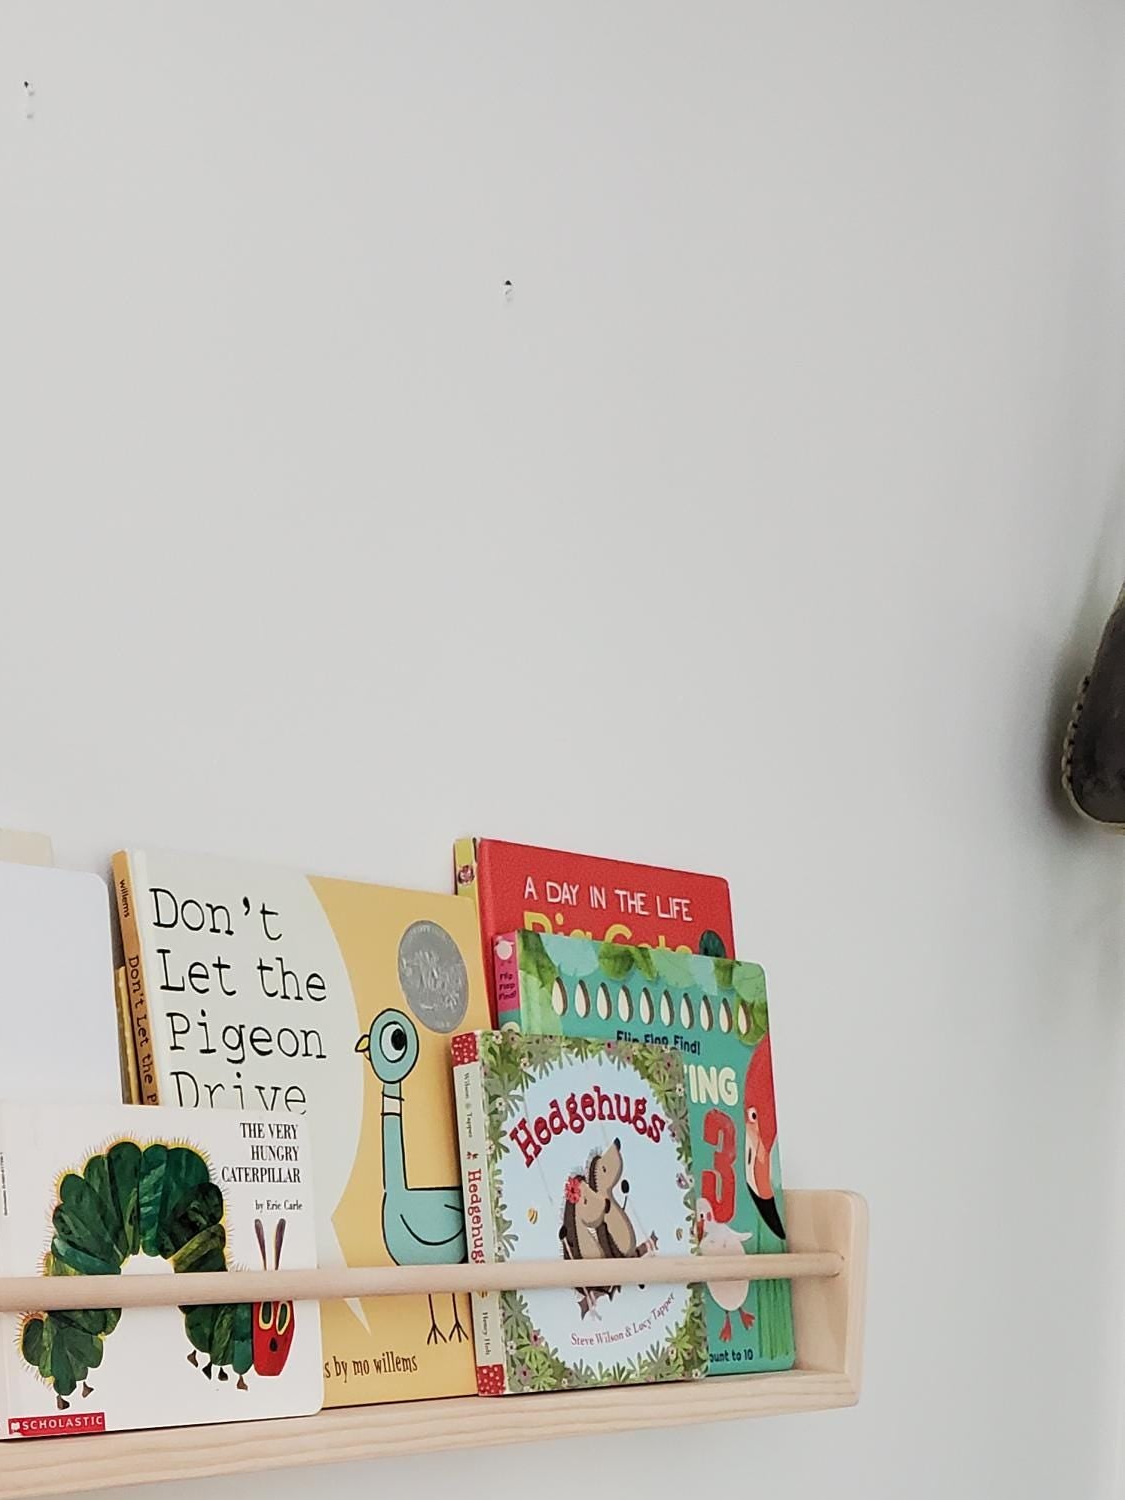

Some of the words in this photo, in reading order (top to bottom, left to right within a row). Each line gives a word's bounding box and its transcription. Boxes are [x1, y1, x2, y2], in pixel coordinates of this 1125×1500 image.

[119, 879, 129, 918] willems
[149, 887, 282, 941] Don't
[524, 876, 539, 900] A
[546, 881, 579, 905] DAY
[590, 884, 607, 910] IN
[614, 889, 649, 915] THE
[656, 895, 693, 922] LIFE
[128, 955, 144, 1007] Don't
[156, 948, 237, 996] Let
[257, 956, 327, 1002] the
[136, 1014, 150, 1048] Let
[166, 1008, 327, 1065] Pigeon
[141, 1052, 153, 1085] the
[170, 1070, 307, 1115] Drive
[240, 1122, 265, 1139] THE
[268, 1123, 298, 1139] VERY
[509, 1085, 666, 1168] Hedgehugs
[251, 1145, 299, 1161] HUNGRY
[701, 1108, 738, 1224] 3
[221, 1166, 301, 1183] CATERPILLAR
[255, 1200, 264, 1213] by
[266, 1200, 281, 1210] Eric
[284, 1200, 303, 1210] Carle
[571, 1332, 594, 1346] Steve
[595, 1331, 624, 1345] Wilson
[625, 1327, 632, 1338] &
[651, 1293, 675, 1320] Tapper
[332, 1355, 347, 1383] by
[352, 1359, 370, 1376] mo
[373, 1351, 418, 1375] willems
[732, 1349, 741, 1361] to
[744, 1348, 753, 1360] 10
[22, 1415, 103, 1431] SCHOLASTIC
